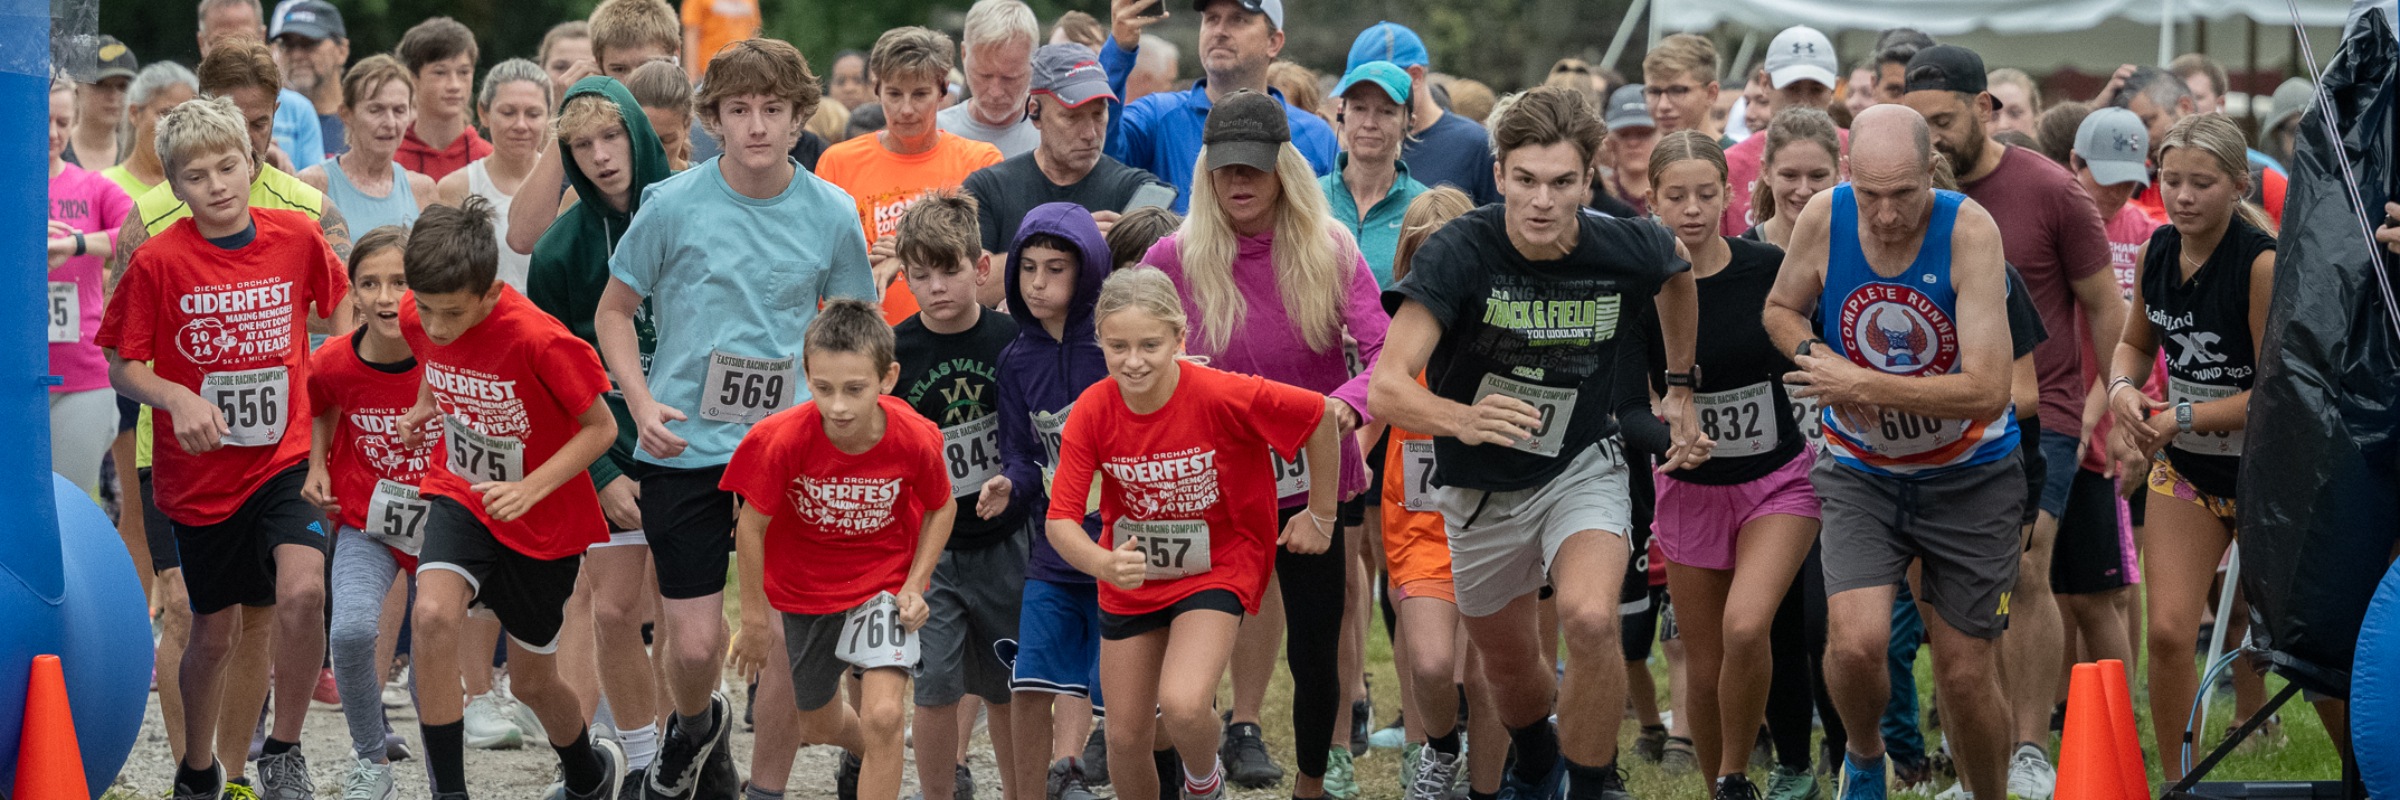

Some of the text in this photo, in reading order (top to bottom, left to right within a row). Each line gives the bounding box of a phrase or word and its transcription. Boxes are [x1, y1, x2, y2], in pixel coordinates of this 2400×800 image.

[58, 199, 89, 218] 2024
[194, 276, 281, 293] DIEHL'S ORCHARD
[180, 281, 293, 314] CIDERFEST
[225, 311, 258, 323] MAKING
[1533, 300, 1547, 328] &
[1548, 300, 1596, 328] FIELD
[1842, 286, 1955, 353] COMPLETE RUNNER
[238, 321, 255, 331] ONE
[256, 319, 273, 330] HOT
[190, 331, 210, 344] 20
[246, 331, 257, 341] AT
[258, 331, 264, 340] A
[264, 327, 282, 338] TIME
[1526, 328, 1593, 339] YOU WOULDN'T
[192, 344, 212, 357] 24
[238, 341, 254, 356] 70
[2169, 331, 2228, 366] XC
[746, 359, 769, 371] RACING
[236, 373, 258, 386] RACING
[460, 368, 500, 381] ORCHARD
[720, 370, 784, 410] 569
[907, 358, 997, 408] ATLAS VALL
[1517, 385, 1542, 398] RACING
[1693, 395, 1717, 405] ASTSIDE
[1717, 392, 1739, 404] RACING
[217, 386, 277, 428] 556
[472, 421, 489, 435] 70
[1701, 402, 1763, 441] 832
[960, 422, 982, 437] RACING
[413, 448, 424, 457] AT
[454, 431, 507, 482] 575
[946, 429, 1001, 480] 843
[1111, 446, 1201, 463] DIEHL'S ORCHARD
[406, 457, 424, 472] 70
[1102, 449, 1216, 482] CIDERFEST
[1418, 457, 1434, 493] 7
[406, 489, 420, 501] RAC
[1177, 494, 1184, 502] A
[827, 499, 860, 510] MAKING
[384, 500, 427, 539] 57
[844, 511, 855, 519] AT
[856, 511, 863, 519] A
[836, 518, 852, 528] 70
[1145, 524, 1170, 534] RACING
[849, 609, 906, 655] 766
